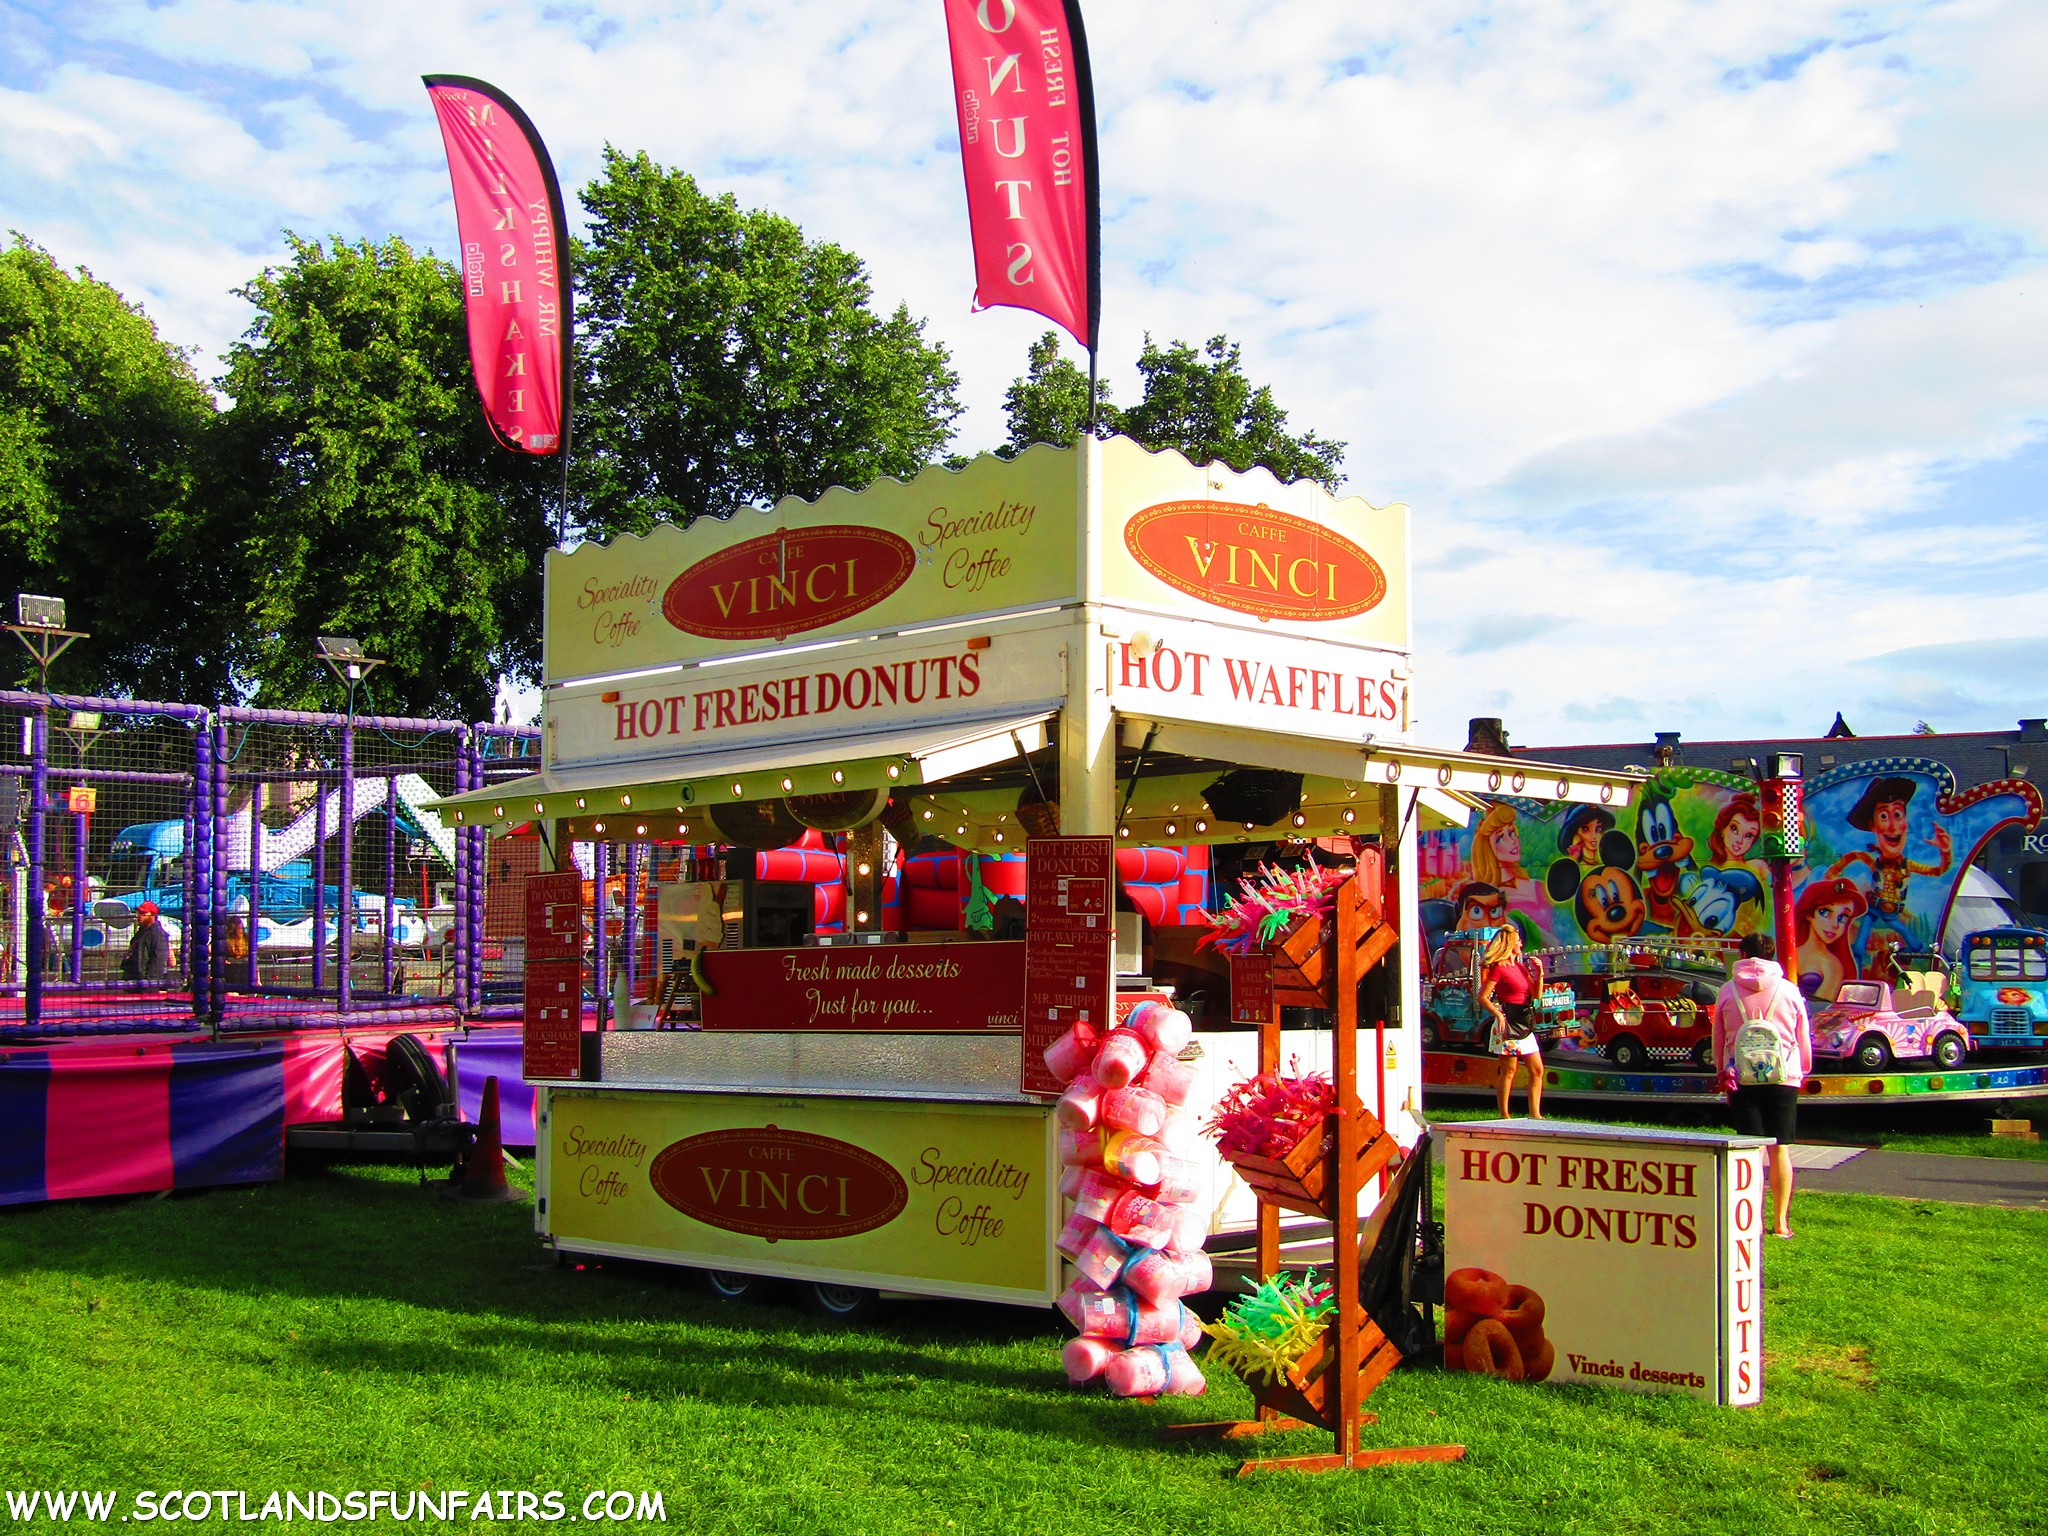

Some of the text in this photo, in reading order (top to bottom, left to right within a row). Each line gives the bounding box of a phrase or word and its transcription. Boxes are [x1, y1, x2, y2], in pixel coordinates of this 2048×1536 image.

[917, 501, 1036, 549] Speciality
[1238, 522, 1287, 543] CAFFE
[758, 545, 804, 565] CAFE
[943, 548, 1013, 593] Coffee
[1184, 535, 1339, 602] VINCI
[578, 574, 659, 611] Speciality
[709, 558, 859, 619] VINCI
[593, 611, 643, 648] Coffee
[614, 652, 980, 741] HOT FRESH DONUTS
[1118, 641, 1397, 721] HOT WAFFLES
[76, 793, 90, 811] 6
[1030, 842, 1108, 856] HOT FRESH
[1037, 857, 1099, 872] DONUTS
[527, 876, 579, 889] HOT FRESH
[531, 888, 573, 902] DONUTS
[781, 954, 963, 981] Fresh made desserts
[805, 988, 934, 1024] Just for you...
[1054, 993, 1100, 1007] WHIPPY
[562, 1125, 647, 1168] Speciality
[748, 1145, 796, 1163] CAFFE
[579, 1164, 629, 1205] Coffee
[699, 1166, 852, 1218] VINCI
[911, 1146, 1030, 1201] Speciality
[1460, 1149, 1698, 1198] HOT FRESH
[935, 1196, 1006, 1246] Coffee
[1523, 1202, 1698, 1249] DONUTS
[1735, 1157, 1752, 1396] DONUTS
[1567, 1353, 1706, 1389] Vincis desserts
